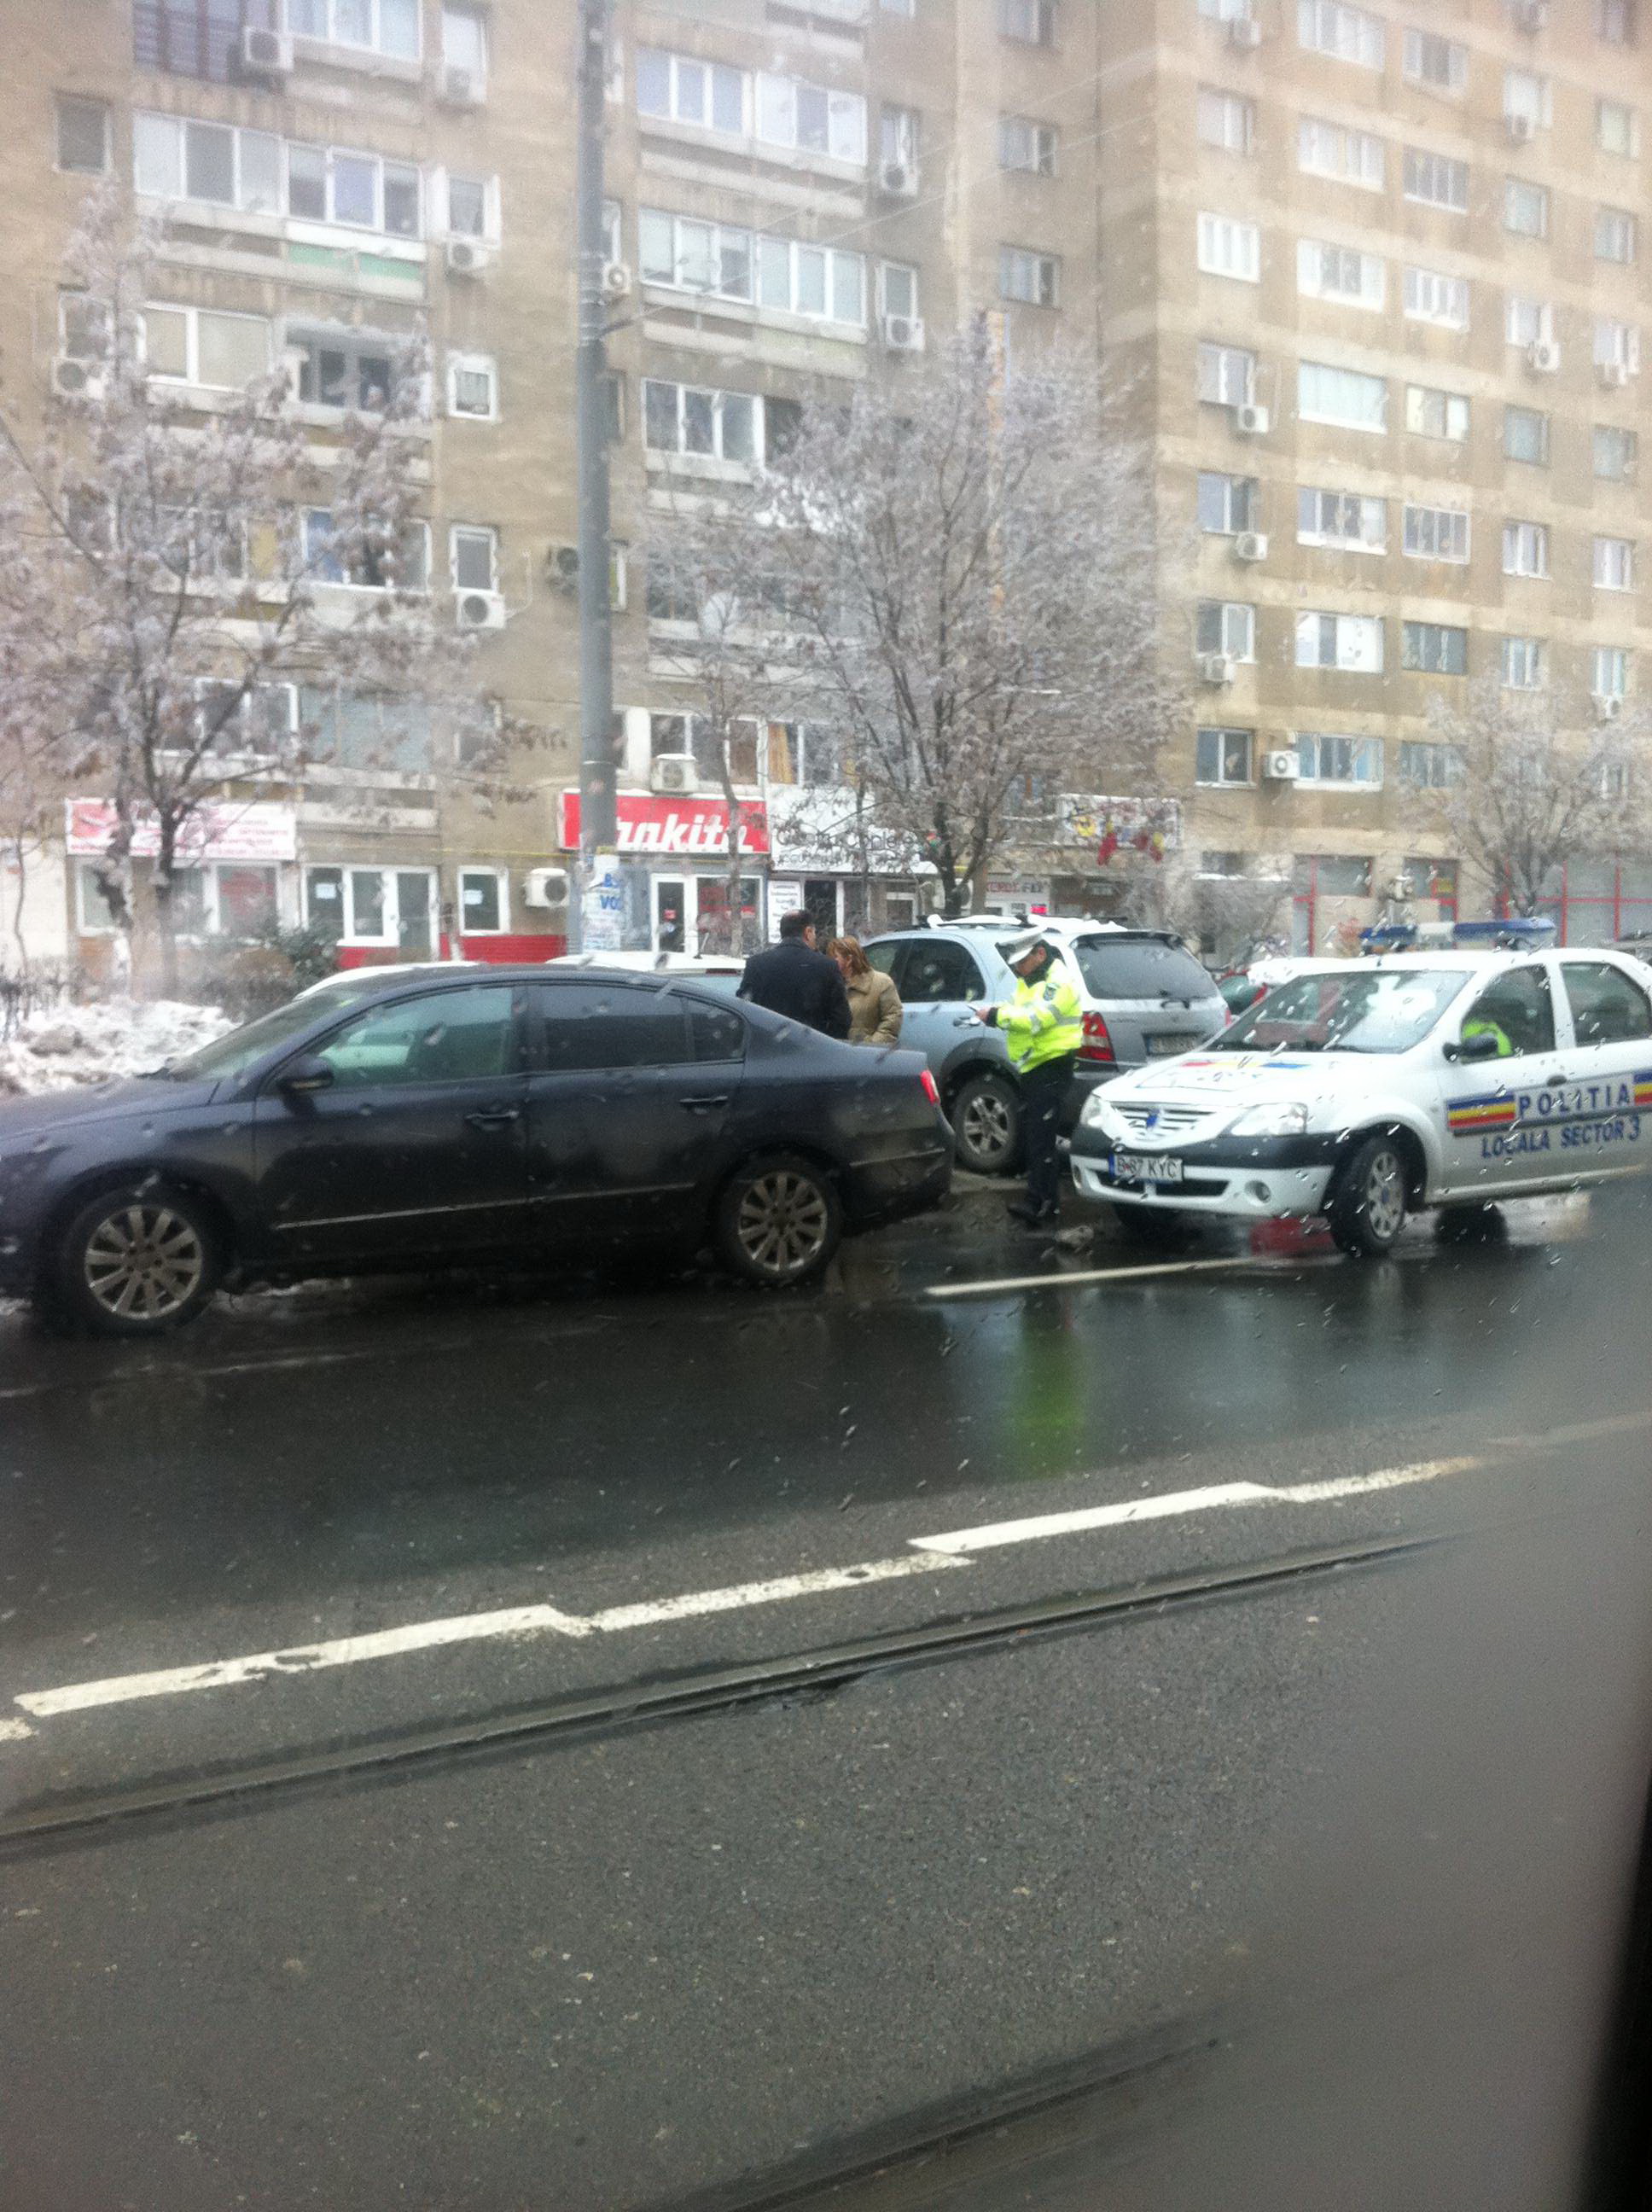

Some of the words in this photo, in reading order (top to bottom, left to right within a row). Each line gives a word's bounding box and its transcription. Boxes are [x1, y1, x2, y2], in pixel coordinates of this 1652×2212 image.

[1518, 1083, 1630, 1120] POLITIA
[1481, 1129, 1550, 1159] LOCALA
[1561, 1119, 1625, 1149] SECTOR
